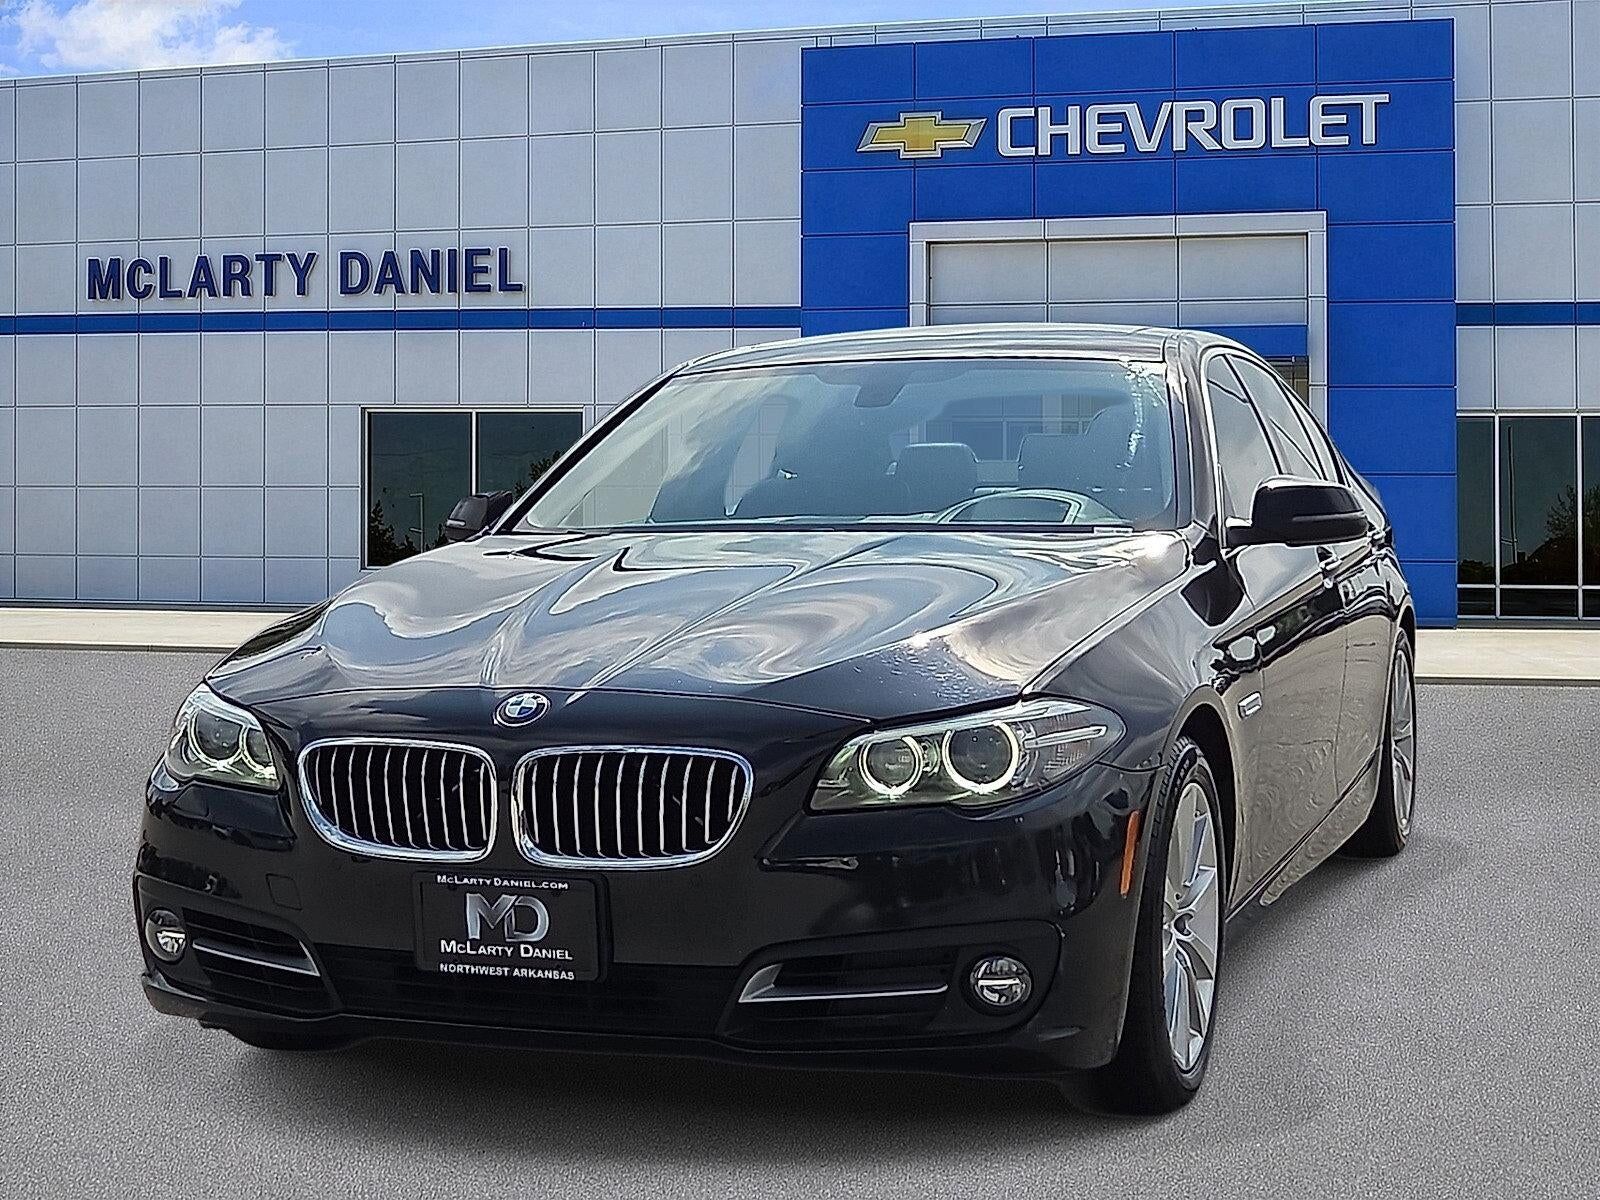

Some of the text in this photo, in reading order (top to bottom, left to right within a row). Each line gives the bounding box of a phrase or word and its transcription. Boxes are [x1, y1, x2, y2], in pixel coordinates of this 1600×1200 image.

[996, 93, 1391, 159] CHEVROLET
[86, 247, 525, 301] MCLARTY DANIEL
[466, 892, 550, 942] MD
[439, 962, 575, 981] NORTHWEST ARKANSAS
[520, 943, 574, 961] DANIEL
